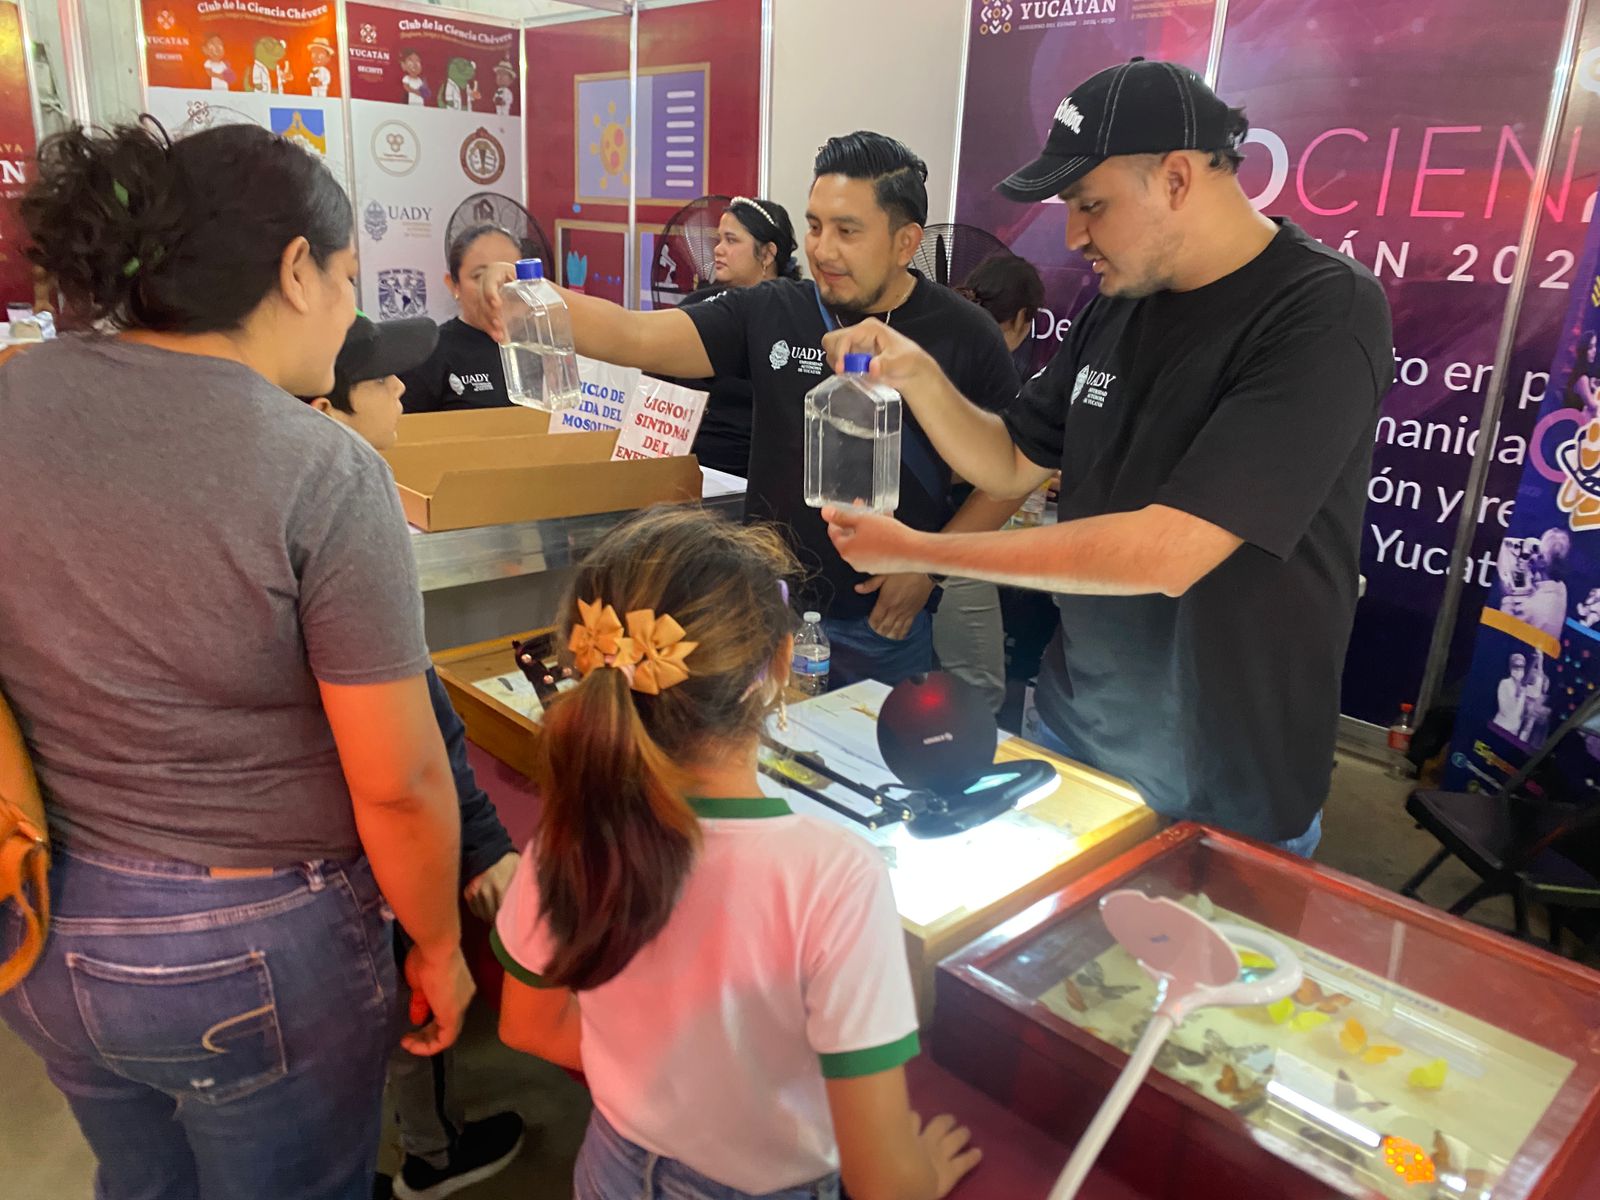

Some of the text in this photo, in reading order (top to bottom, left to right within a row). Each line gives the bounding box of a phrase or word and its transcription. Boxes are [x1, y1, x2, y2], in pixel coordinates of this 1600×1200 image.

[197, 1, 221, 13] Club
[222, 0, 235, 10] de
[247, 2, 286, 18] Ciencia
[398, 19, 420, 30] Club
[421, 19, 433, 30] de
[434, 21, 443, 31] la
[444, 24, 477, 41] Ciencia
[387, 206, 433, 221] UADY
[791, 346, 827, 361] UADY
[460, 373, 489, 385] UADY
[610, 388, 626, 404] DE
[602, 404, 623, 423] DEL
[1436, 486, 1465, 523] y
